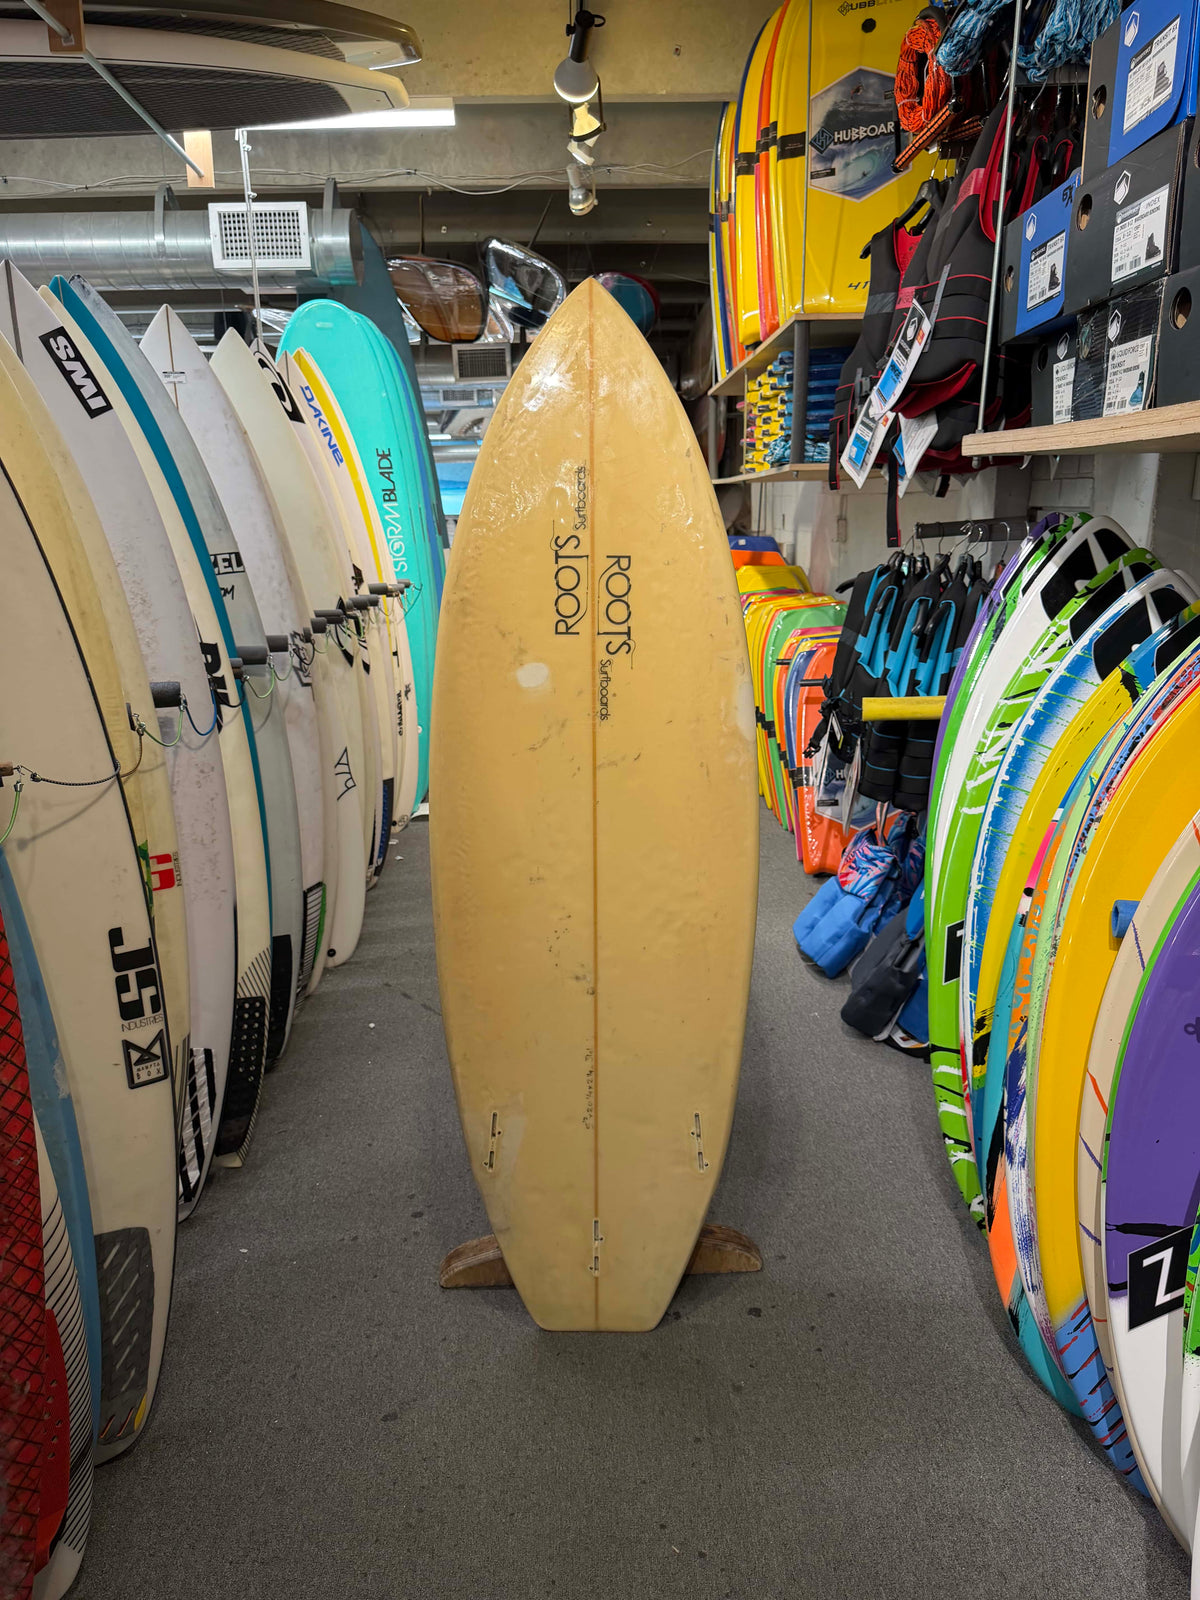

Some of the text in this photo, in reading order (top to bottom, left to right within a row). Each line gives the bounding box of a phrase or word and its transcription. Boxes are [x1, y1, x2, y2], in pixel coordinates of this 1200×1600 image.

[833, 121, 895, 143] HUBBOAR
[49, 335, 107, 409] SMI
[300, 386, 344, 467] DAKINE
[381, 447, 408, 573] STORMBLADE
[574, 465, 587, 531] Surfboards
[550, 521, 589, 635] ROOTS
[597, 555, 634, 660] ROOTS
[599, 658, 611, 721] Surfboards
[108, 926, 161, 1021] JS
[121, 1012, 164, 1033] INDUSTRIES
[136, 1067, 162, 1080] BOX
